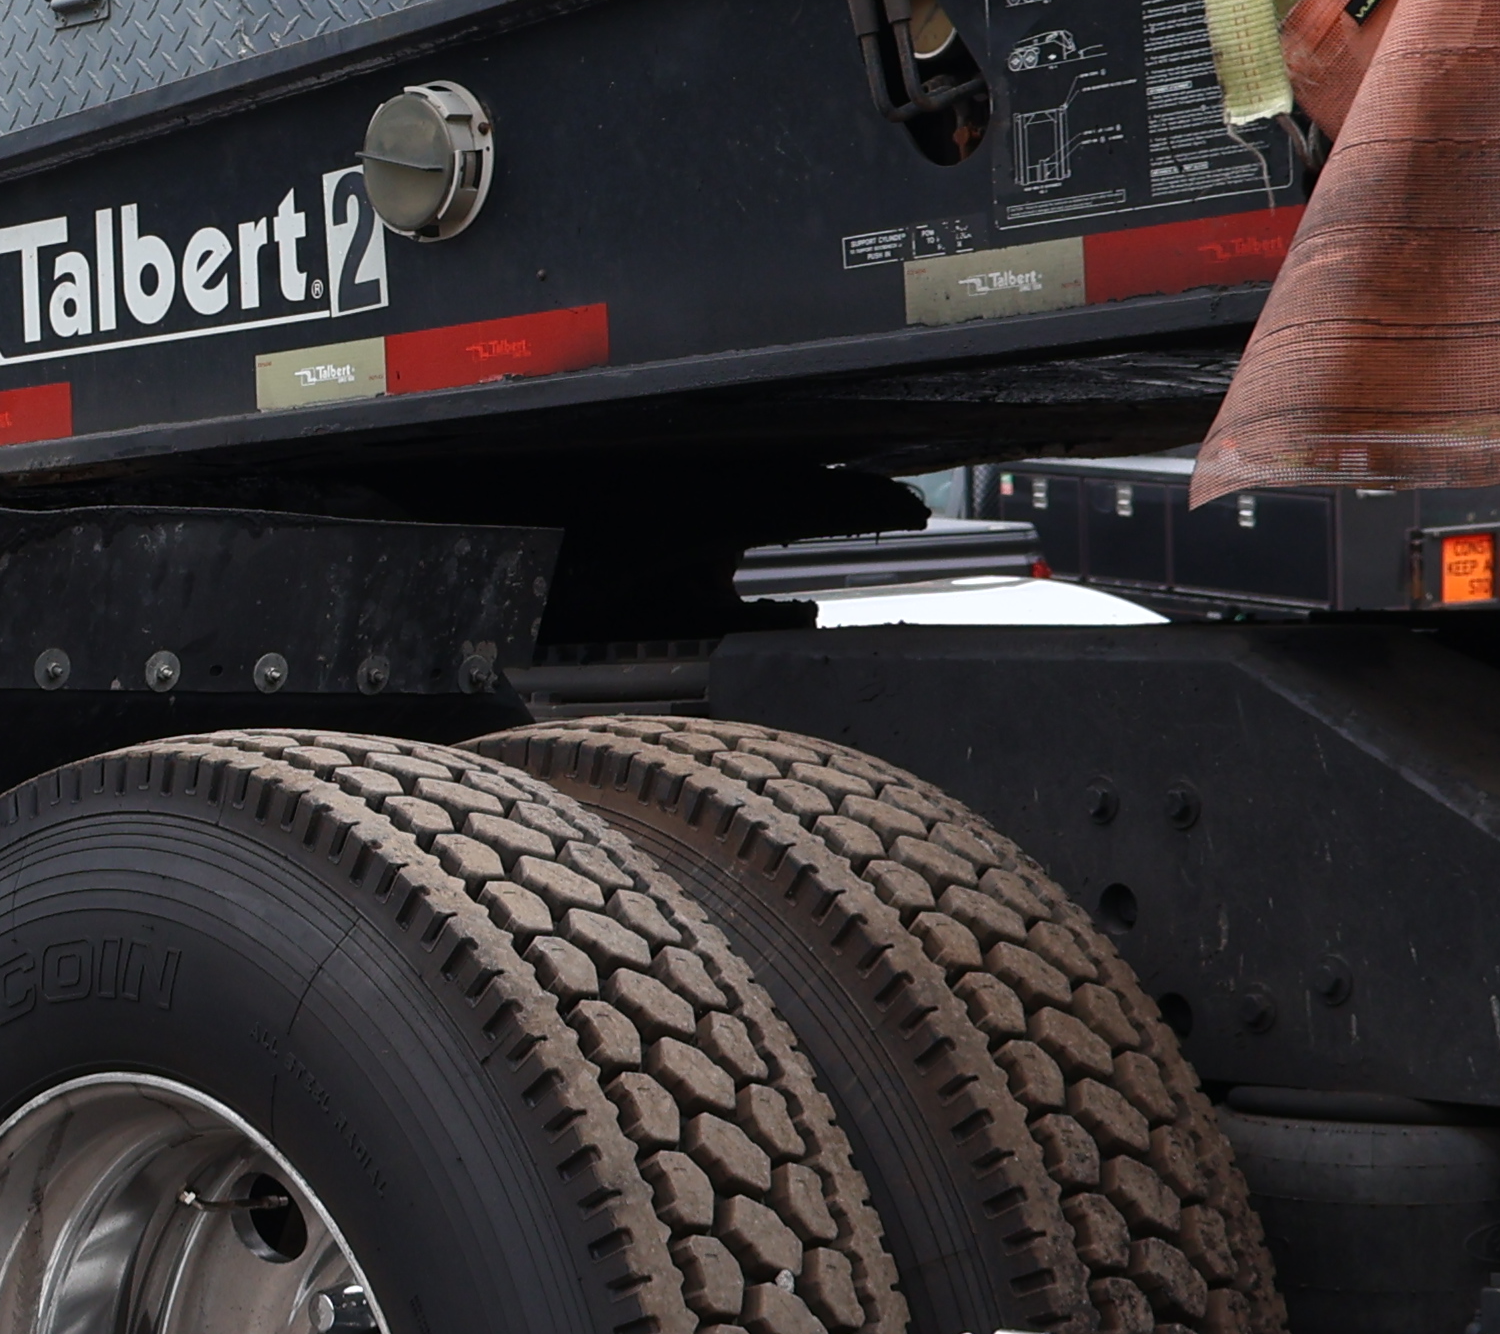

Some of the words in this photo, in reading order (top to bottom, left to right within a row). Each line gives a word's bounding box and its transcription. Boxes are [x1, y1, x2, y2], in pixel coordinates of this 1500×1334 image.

[332, 170, 382, 313] 2
[850, 237, 877, 248] SUPPORT
[989, 271, 1036, 288] Talbert
